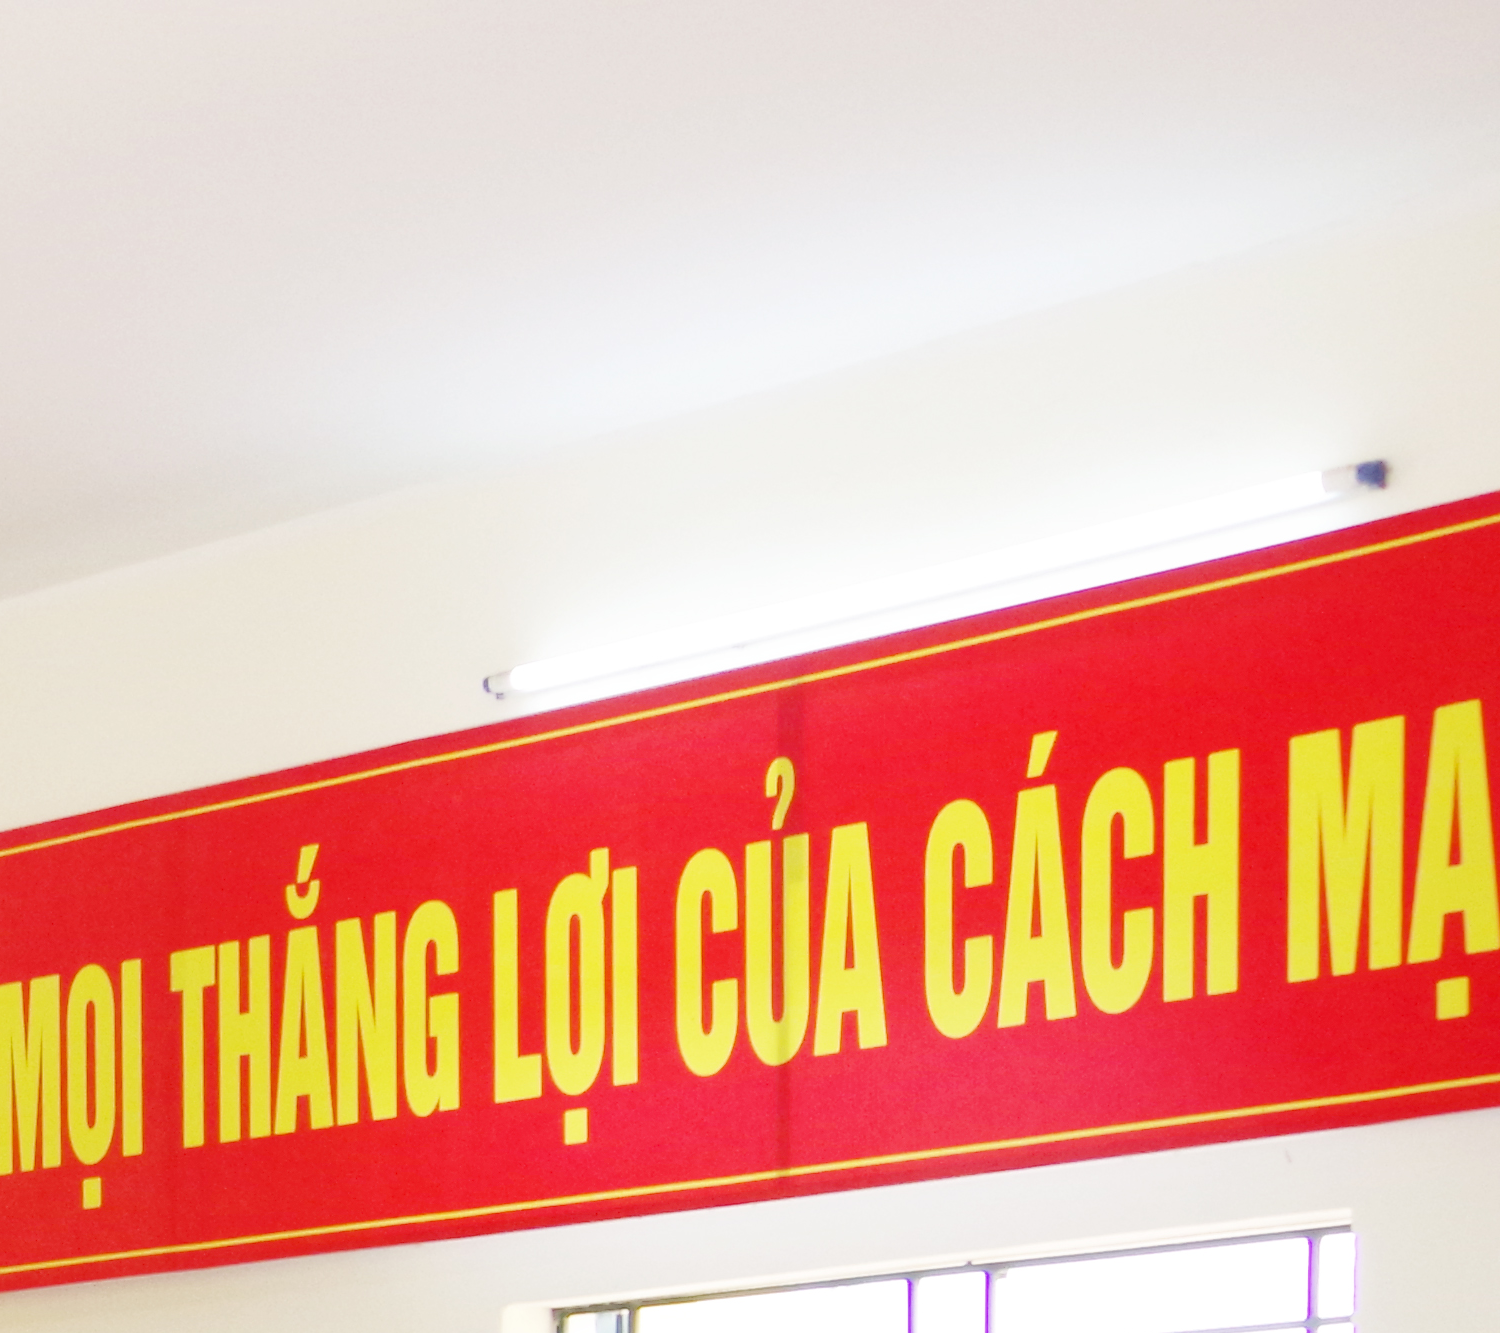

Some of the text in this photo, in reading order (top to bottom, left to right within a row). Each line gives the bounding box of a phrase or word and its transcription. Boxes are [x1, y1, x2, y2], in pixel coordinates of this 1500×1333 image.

[170, 844, 460, 1148] THẮNG
[493, 847, 639, 1146] LỢI
[675, 757, 888, 1077] CỦA
[924, 730, 1240, 1040] CÁCH
